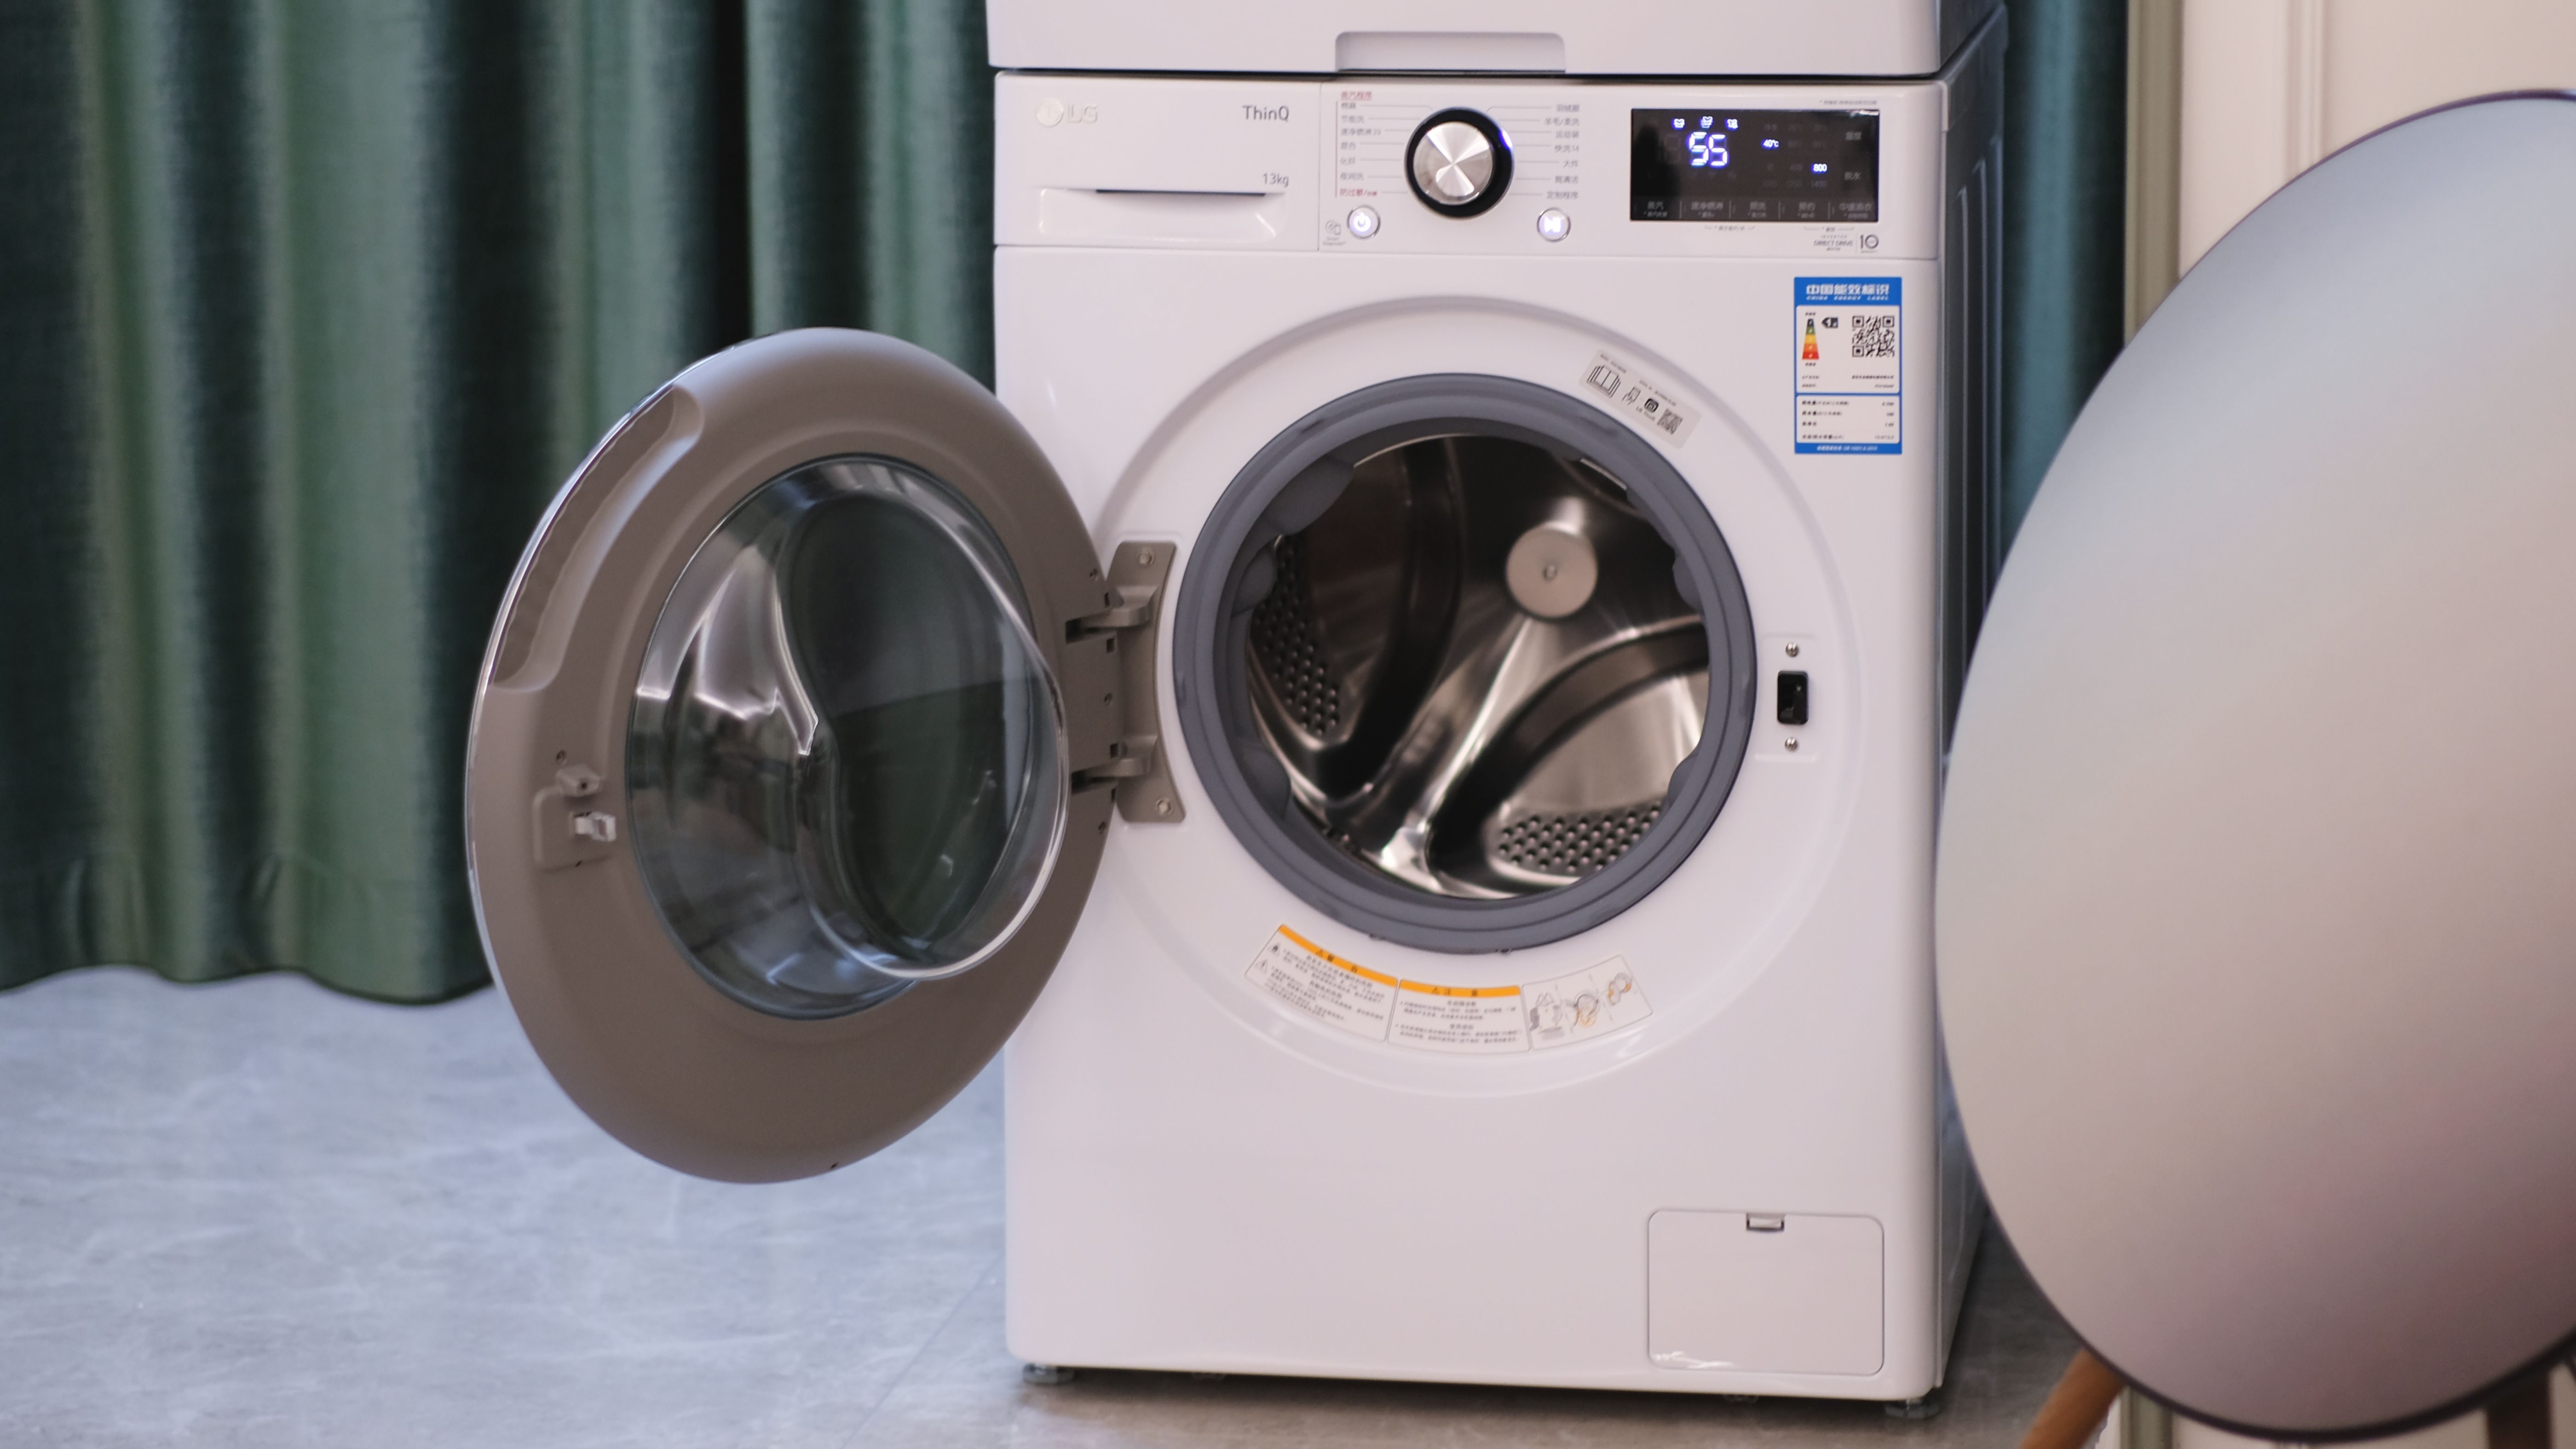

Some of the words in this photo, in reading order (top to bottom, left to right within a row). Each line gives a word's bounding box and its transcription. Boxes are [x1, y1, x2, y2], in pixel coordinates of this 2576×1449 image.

[1068, 104, 1098, 123] LG
[1242, 105, 1289, 122] ThinQ
[1688, 132, 1729, 167] 55
[1813, 163, 1828, 172] 800
[1262, 173, 1289, 188] 13kg
[1860, 234, 1879, 249] 10
[1806, 283, 1890, 295] 中国能效标识
